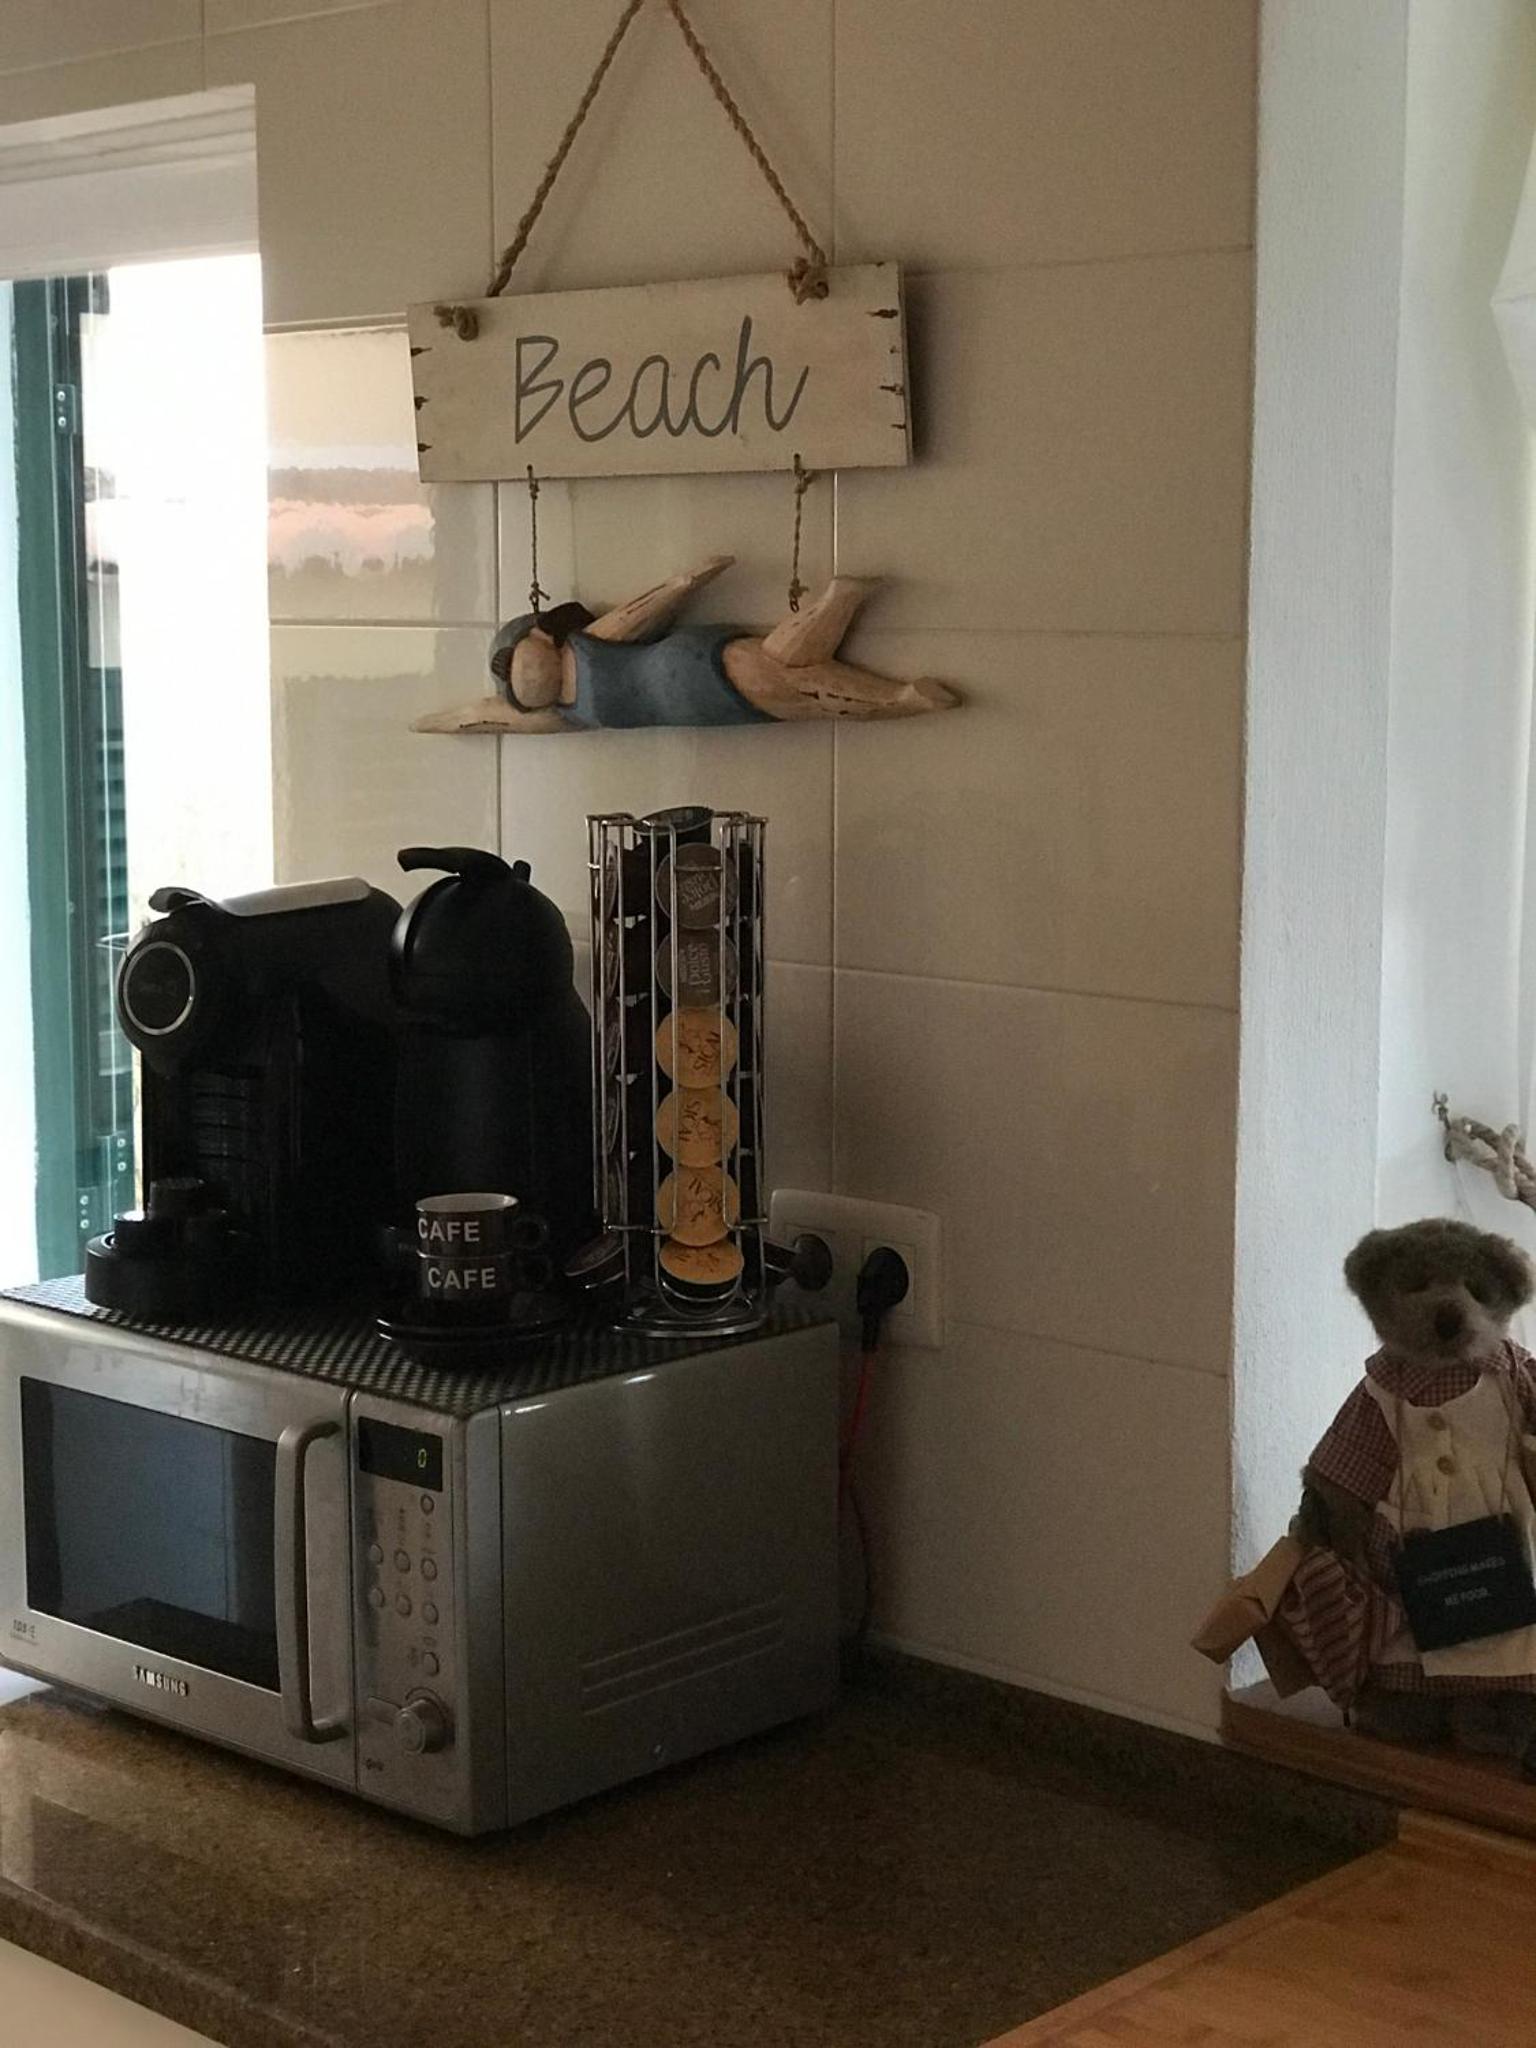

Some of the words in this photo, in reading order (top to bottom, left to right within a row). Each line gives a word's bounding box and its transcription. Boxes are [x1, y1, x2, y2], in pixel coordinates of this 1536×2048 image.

[515, 314, 809, 444] Beach
[418, 1217, 480, 1242] CAFE
[428, 1267, 497, 1290] CAFE
[417, 1447, 427, 1468] 0
[132, 1665, 187, 1697] SAMSUNG
